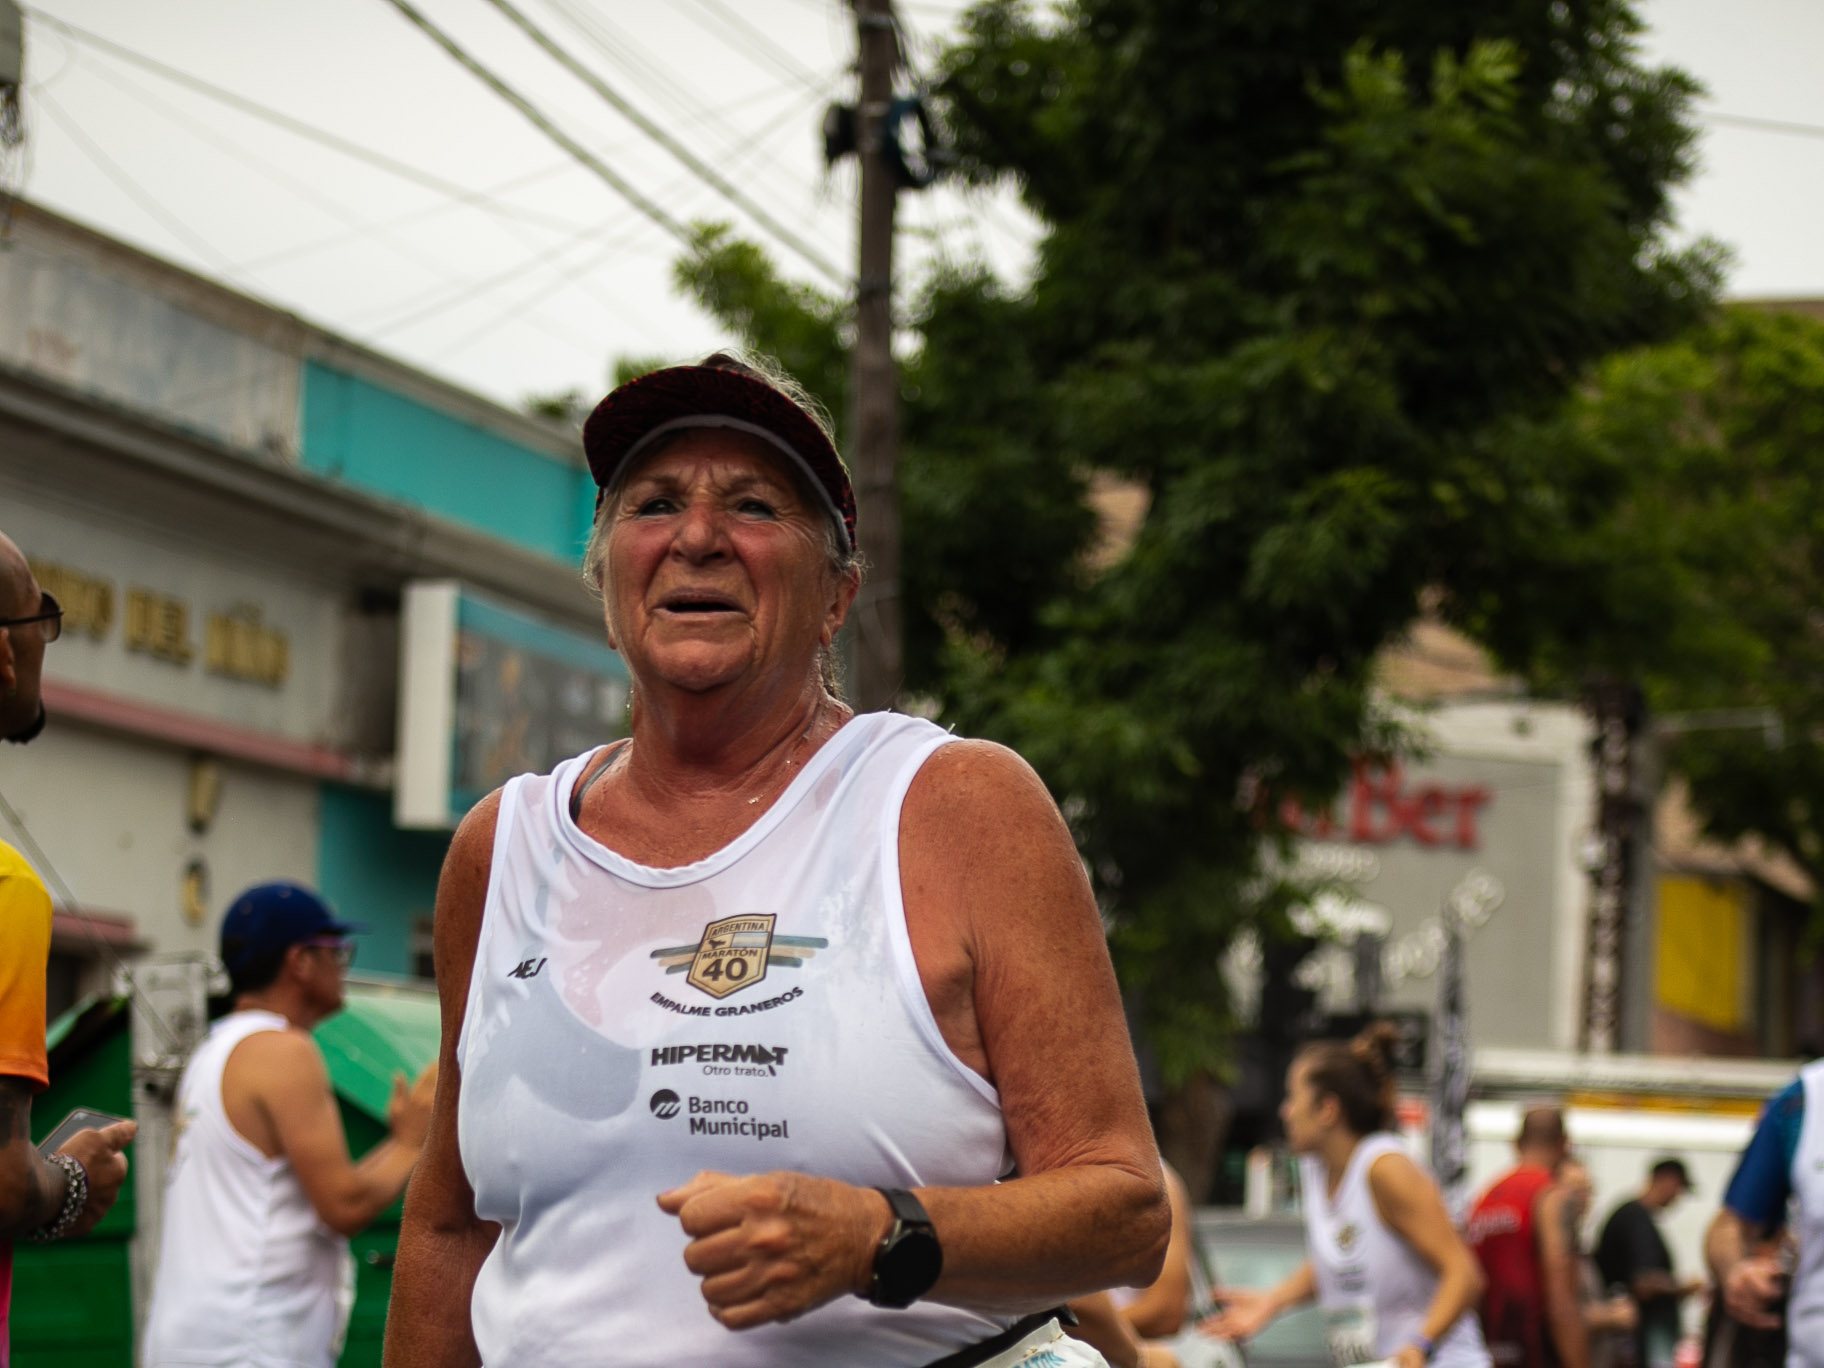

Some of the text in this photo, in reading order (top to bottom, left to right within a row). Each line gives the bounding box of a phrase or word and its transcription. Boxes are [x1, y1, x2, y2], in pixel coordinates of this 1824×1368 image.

[711, 922, 766, 937] ARGENTINA
[701, 946, 758, 960] MARATÓN
[701, 957, 748, 981] 40
[650, 986, 804, 1017] EMPALME GRANEROS
[703, 1065, 731, 1076] Otro
[688, 1096, 749, 1115] Banco
[690, 1117, 790, 1141] Municipal
